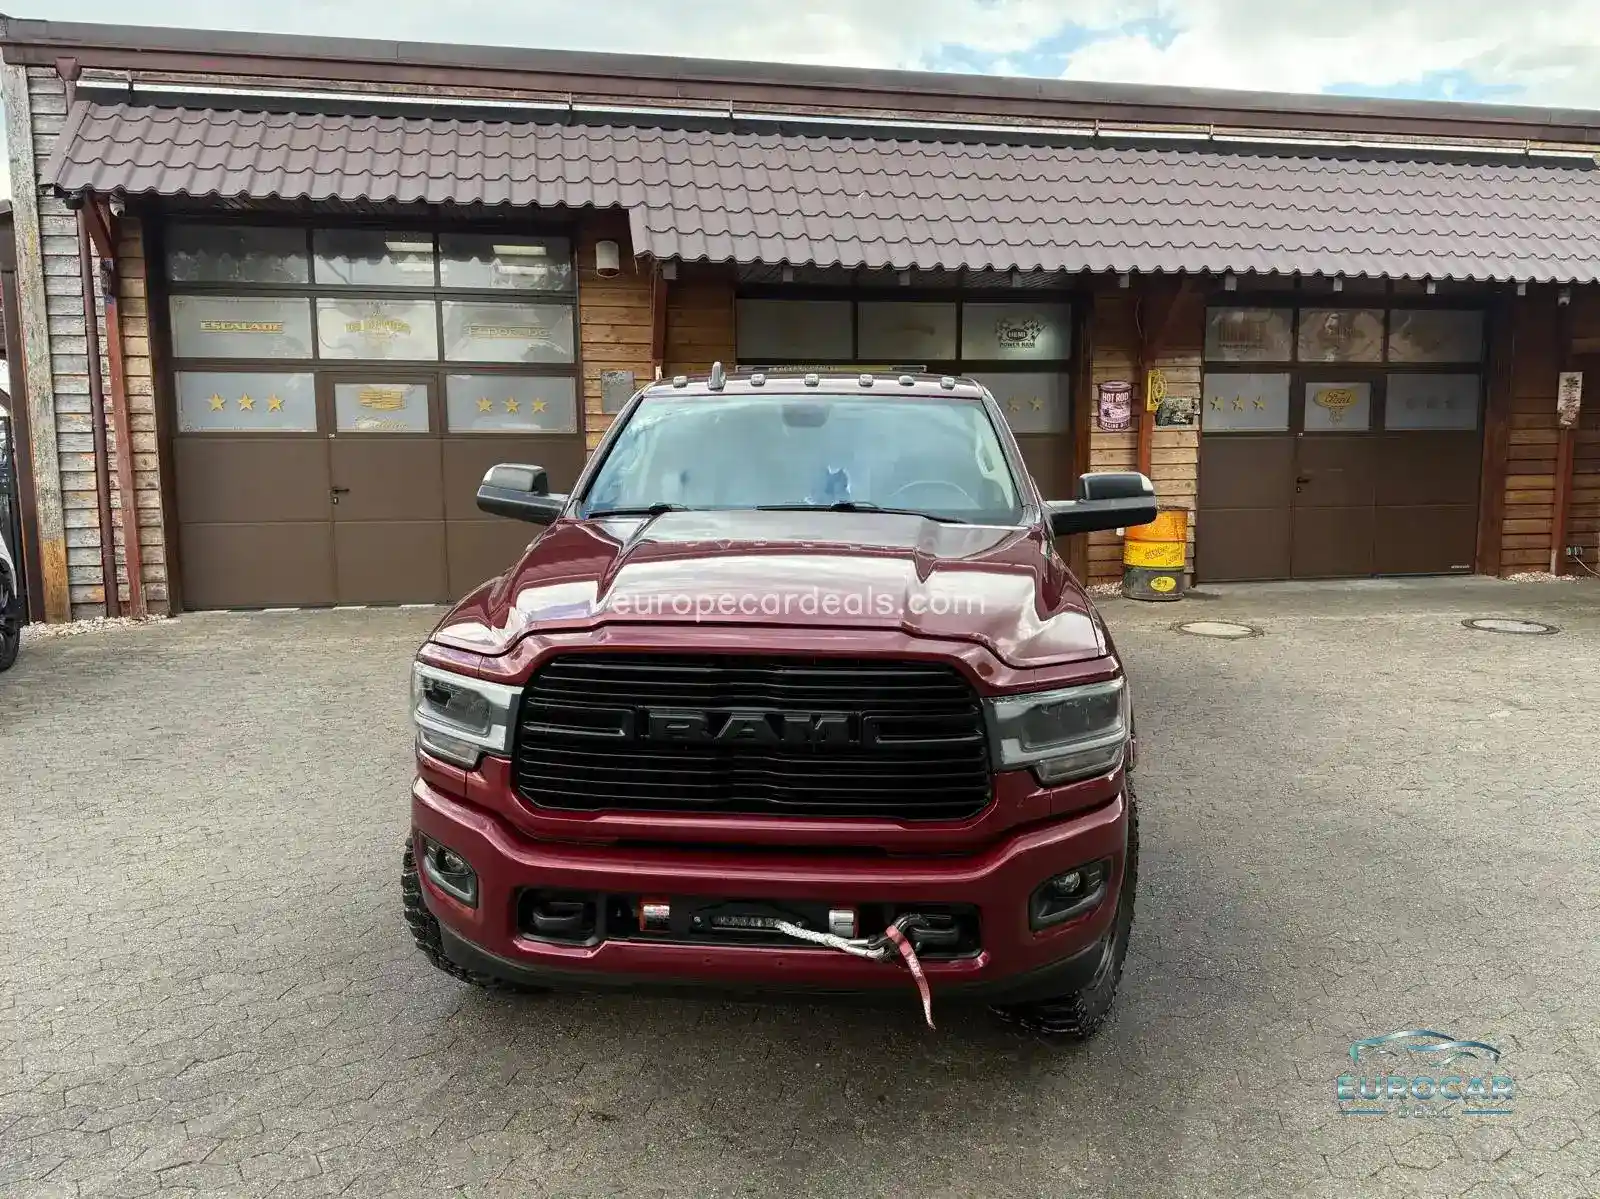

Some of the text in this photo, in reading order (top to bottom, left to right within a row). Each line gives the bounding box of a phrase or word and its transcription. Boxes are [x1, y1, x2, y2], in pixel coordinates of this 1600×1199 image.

[200, 320, 284, 332] ESCALADE
[467, 325, 551, 337] EDORDO
[1102, 391, 1129, 403] HOT ROD
[649, 708, 849, 743] RAM
